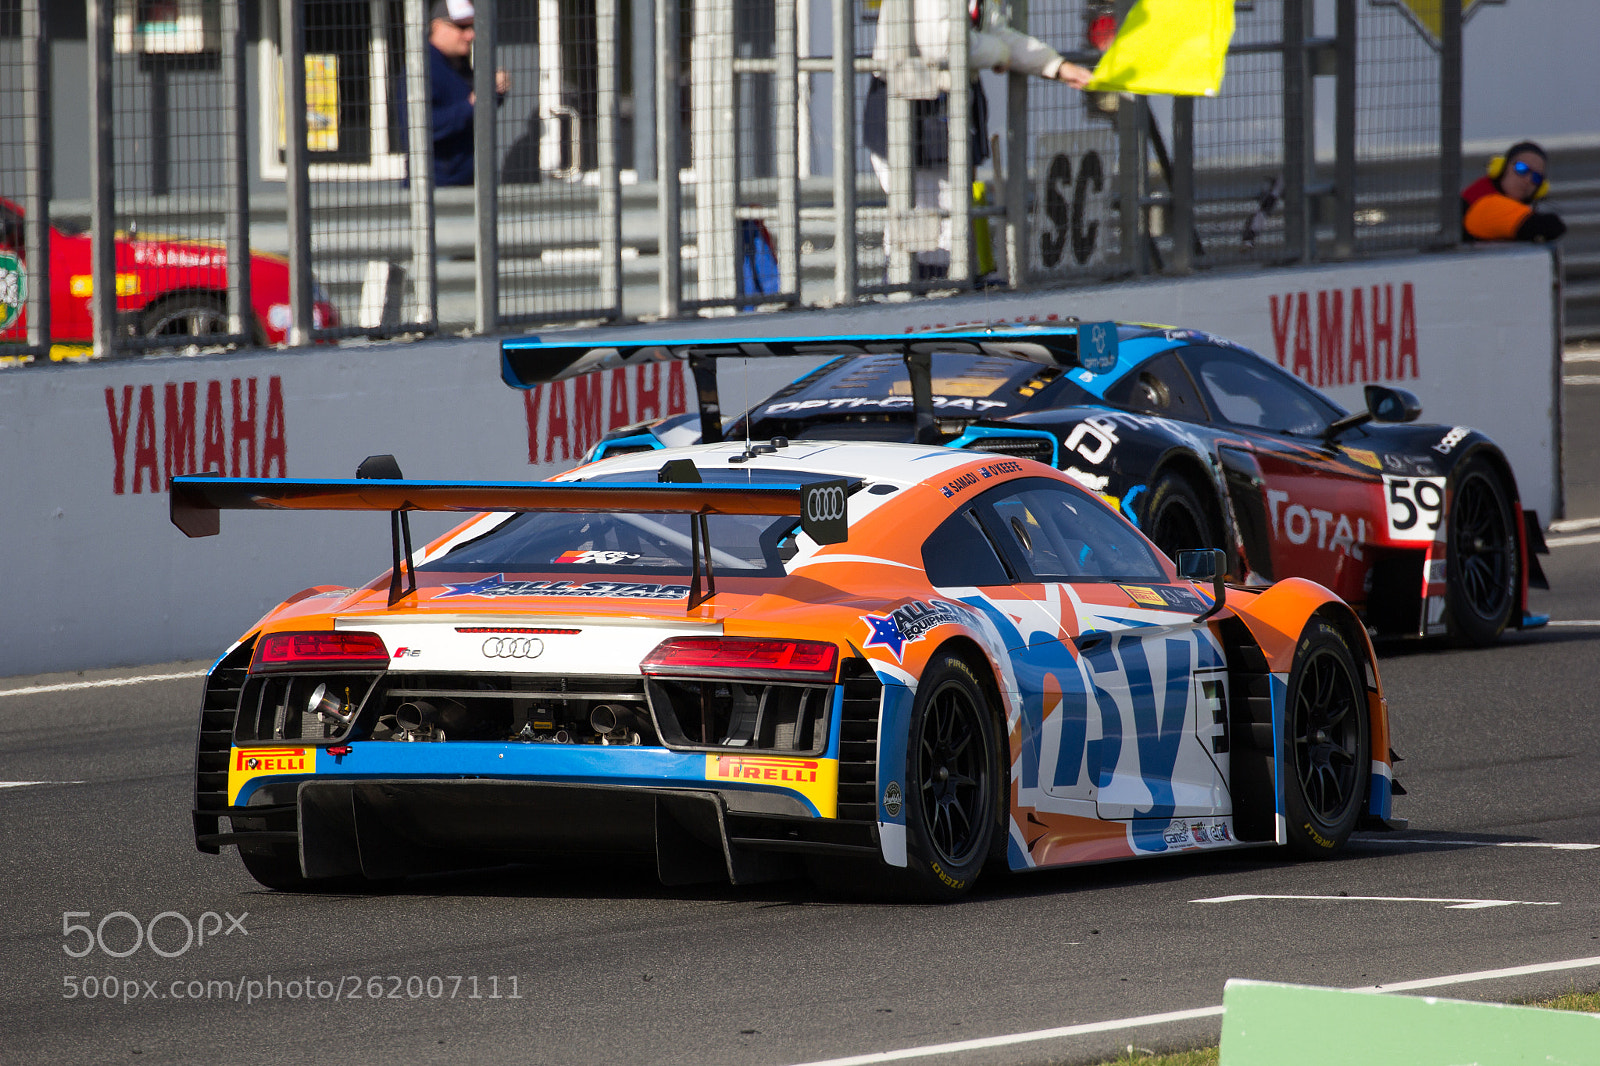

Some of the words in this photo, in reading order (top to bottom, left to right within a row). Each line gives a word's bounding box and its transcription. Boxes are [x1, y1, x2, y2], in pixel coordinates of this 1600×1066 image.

[1042, 151, 1104, 268] SC
[1269, 282, 1420, 387] YAMAHA
[105, 375, 287, 495] YAMAHA
[523, 360, 688, 465] YAMAHA
[948, 472, 980, 493] SAMADI
[988, 461, 1023, 476] O'KEEFE
[1390, 479, 1442, 531] 59
[1266, 489, 1366, 562] TOTAL
[892, 600, 937, 632] ALL
[236, 748, 307, 772] PIRELLI
[719, 756, 818, 783] PIRELLI
